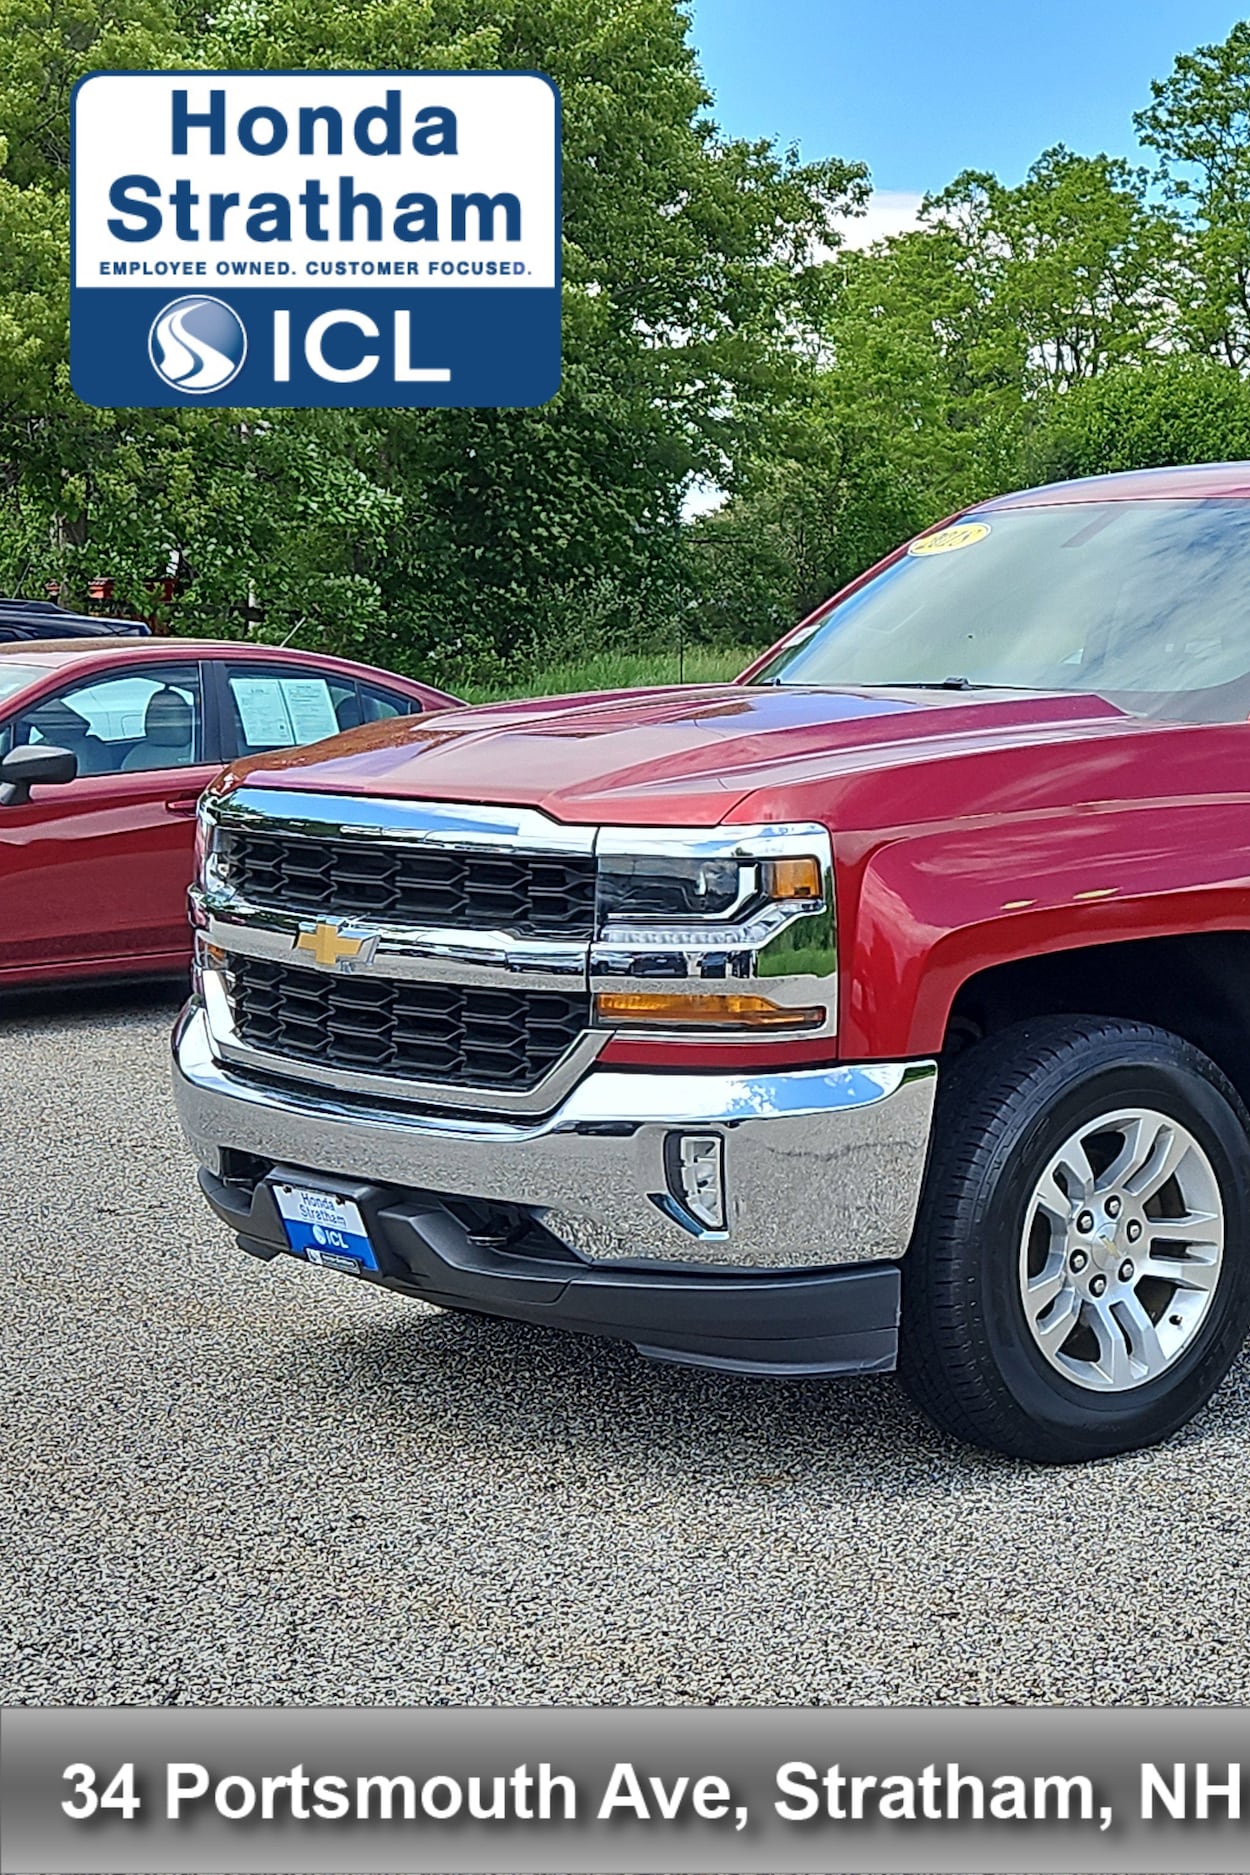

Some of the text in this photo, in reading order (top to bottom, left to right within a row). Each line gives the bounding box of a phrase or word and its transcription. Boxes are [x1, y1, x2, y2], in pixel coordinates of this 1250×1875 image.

[301, 1192, 336, 1211] Honda
[299, 1204, 347, 1227] Stratham
[325, 1230, 349, 1248] ICL
